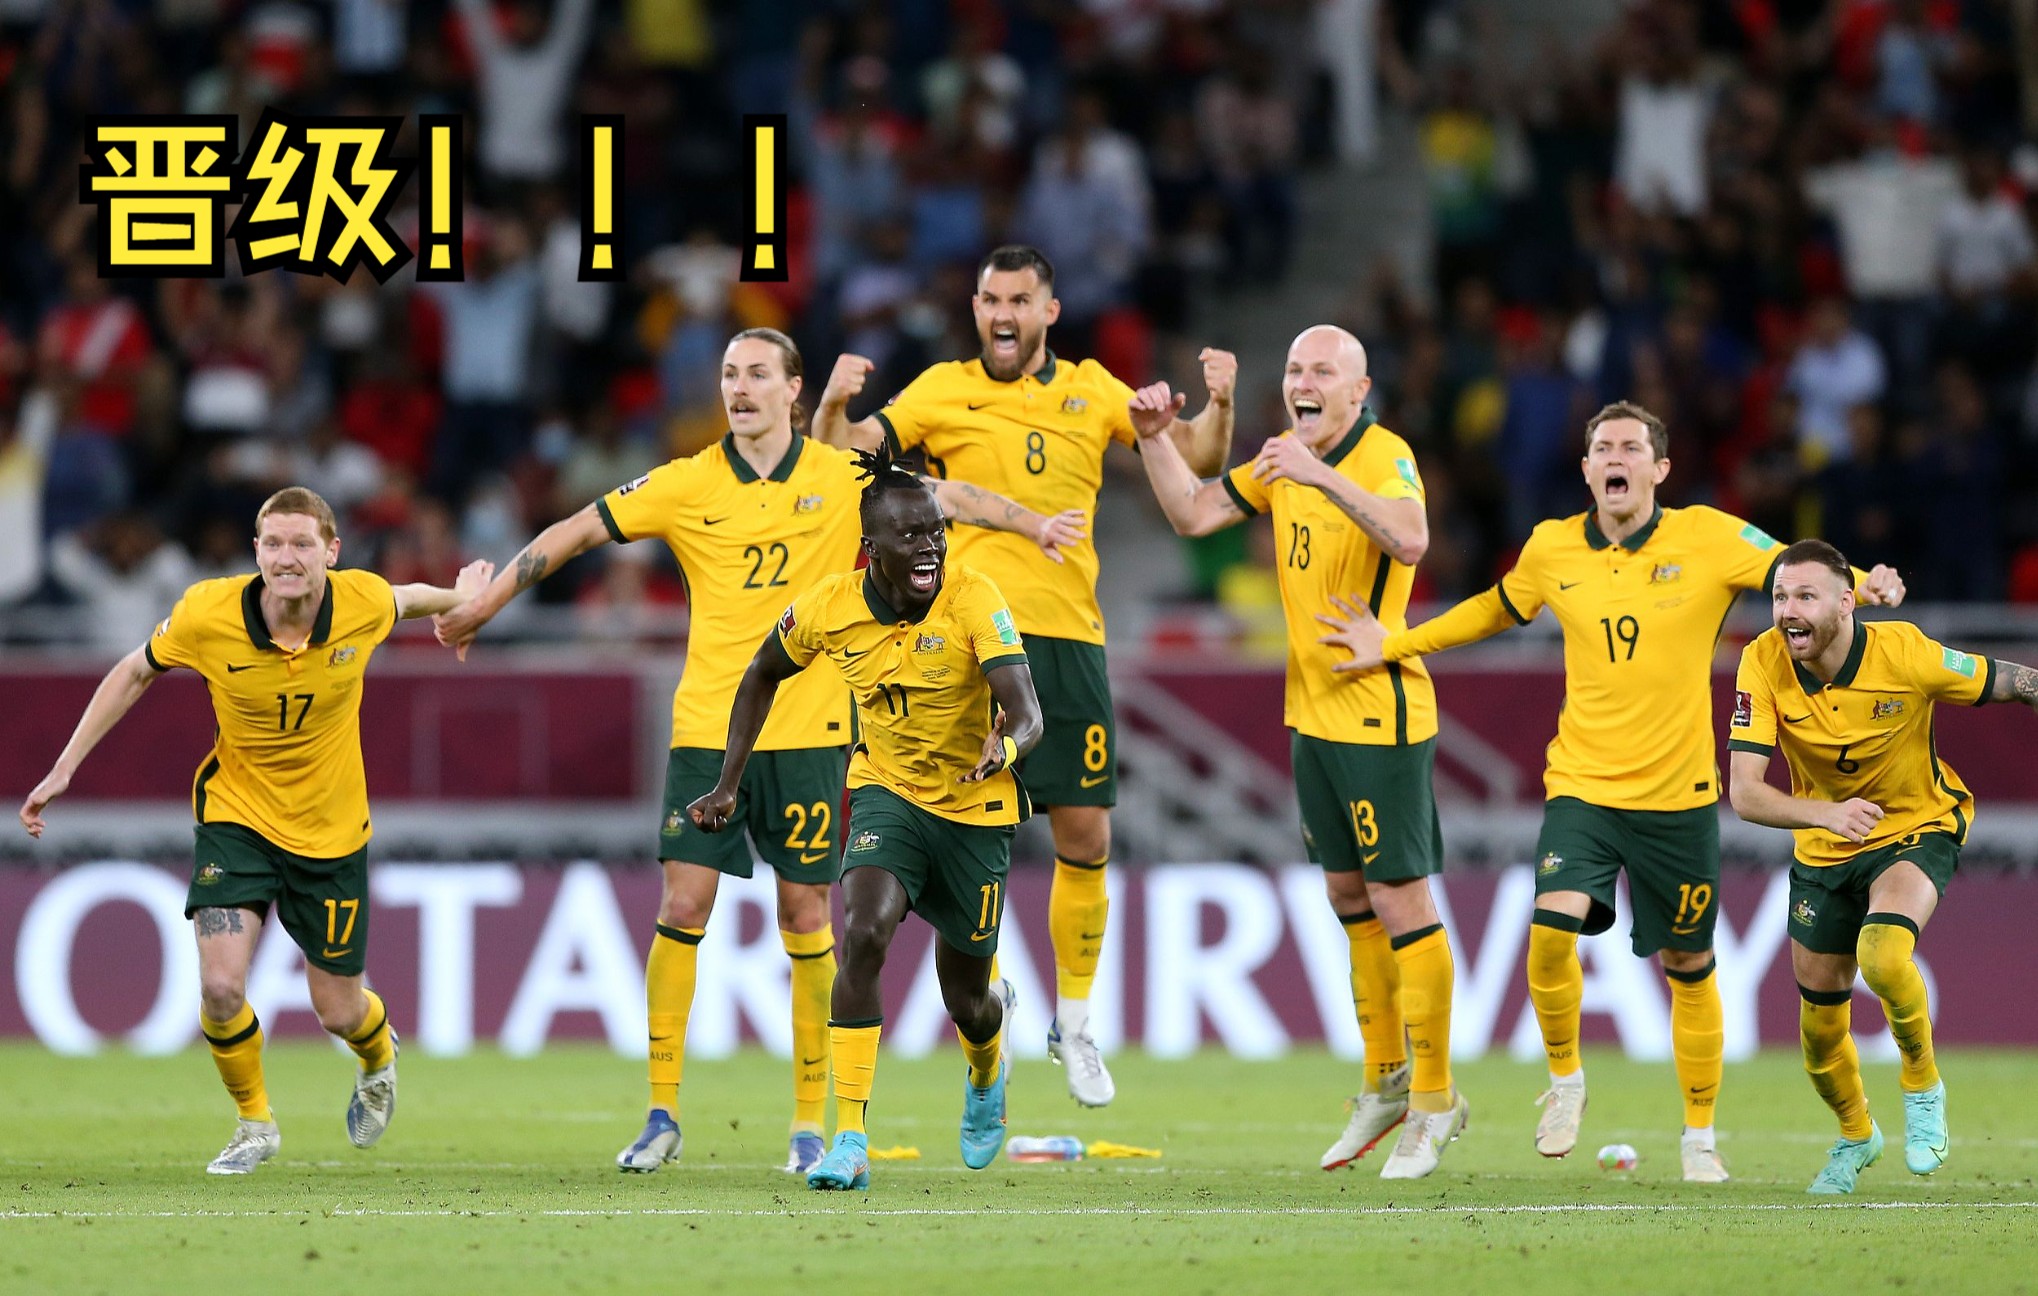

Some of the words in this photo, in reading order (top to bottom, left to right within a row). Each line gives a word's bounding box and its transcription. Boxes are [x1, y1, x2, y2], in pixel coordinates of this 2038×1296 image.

[1025, 430, 1047, 475] 8
[743, 541, 789, 590] 22
[1288, 521, 1310, 570] 13
[1600, 615, 1640, 663] 19
[276, 692, 315, 732] 17
[876, 682, 910, 718] 11
[1083, 723, 1108, 772] 8
[1835, 744, 1860, 774] 6
[784, 801, 831, 849] 22
[1348, 799, 1379, 847] 13
[324, 898, 360, 945] 17
[978, 881, 999, 929] 11
[1677, 883, 1712, 924] 19
[1079, 947, 1100, 958] AU
[650, 1051, 673, 1062] AUS
[1549, 1049, 1573, 1060] AUS
[803, 1071, 826, 1083] AUS
[1692, 1098, 1714, 1107] AUS
